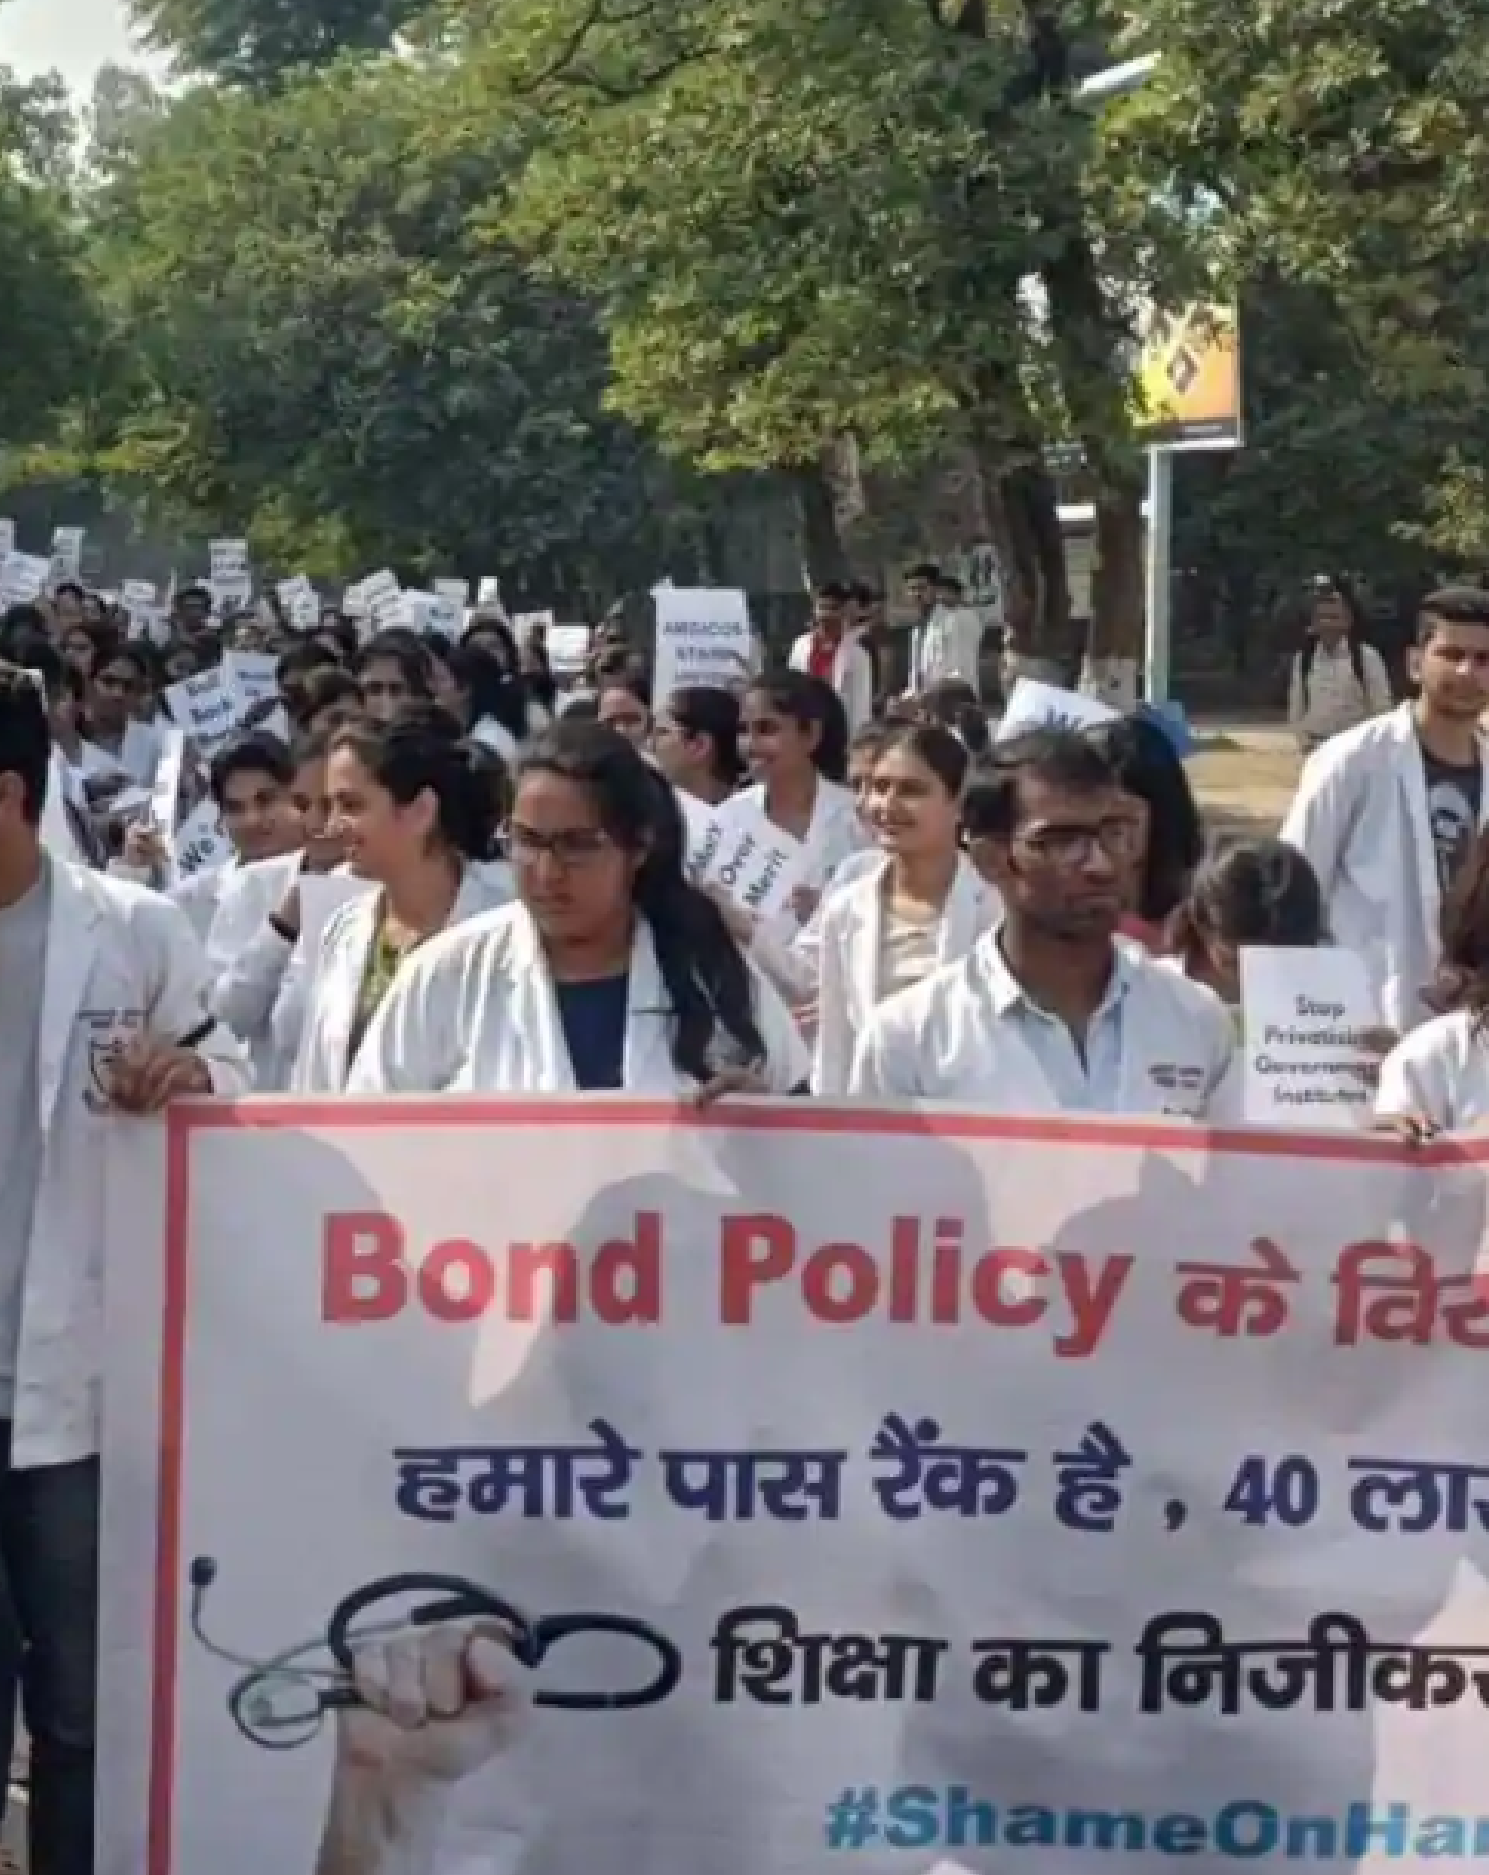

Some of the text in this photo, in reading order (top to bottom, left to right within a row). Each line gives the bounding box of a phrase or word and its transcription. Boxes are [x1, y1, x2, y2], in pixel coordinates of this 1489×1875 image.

[321, 1209, 662, 1326] Bond
[719, 1211, 1135, 1358] Policy
[1174, 1235, 1302, 1337] के
[391, 1417, 644, 1522] हमारे
[657, 1449, 848, 1521] पास
[868, 1411, 1028, 1520] रैंक
[1051, 1419, 1134, 1533] है
[1223, 1454, 1321, 1527] 40
[1347, 1456, 1489, 1534] ला
[710, 1604, 950, 1703] शिक्षा
[971, 1639, 1113, 1711] का
